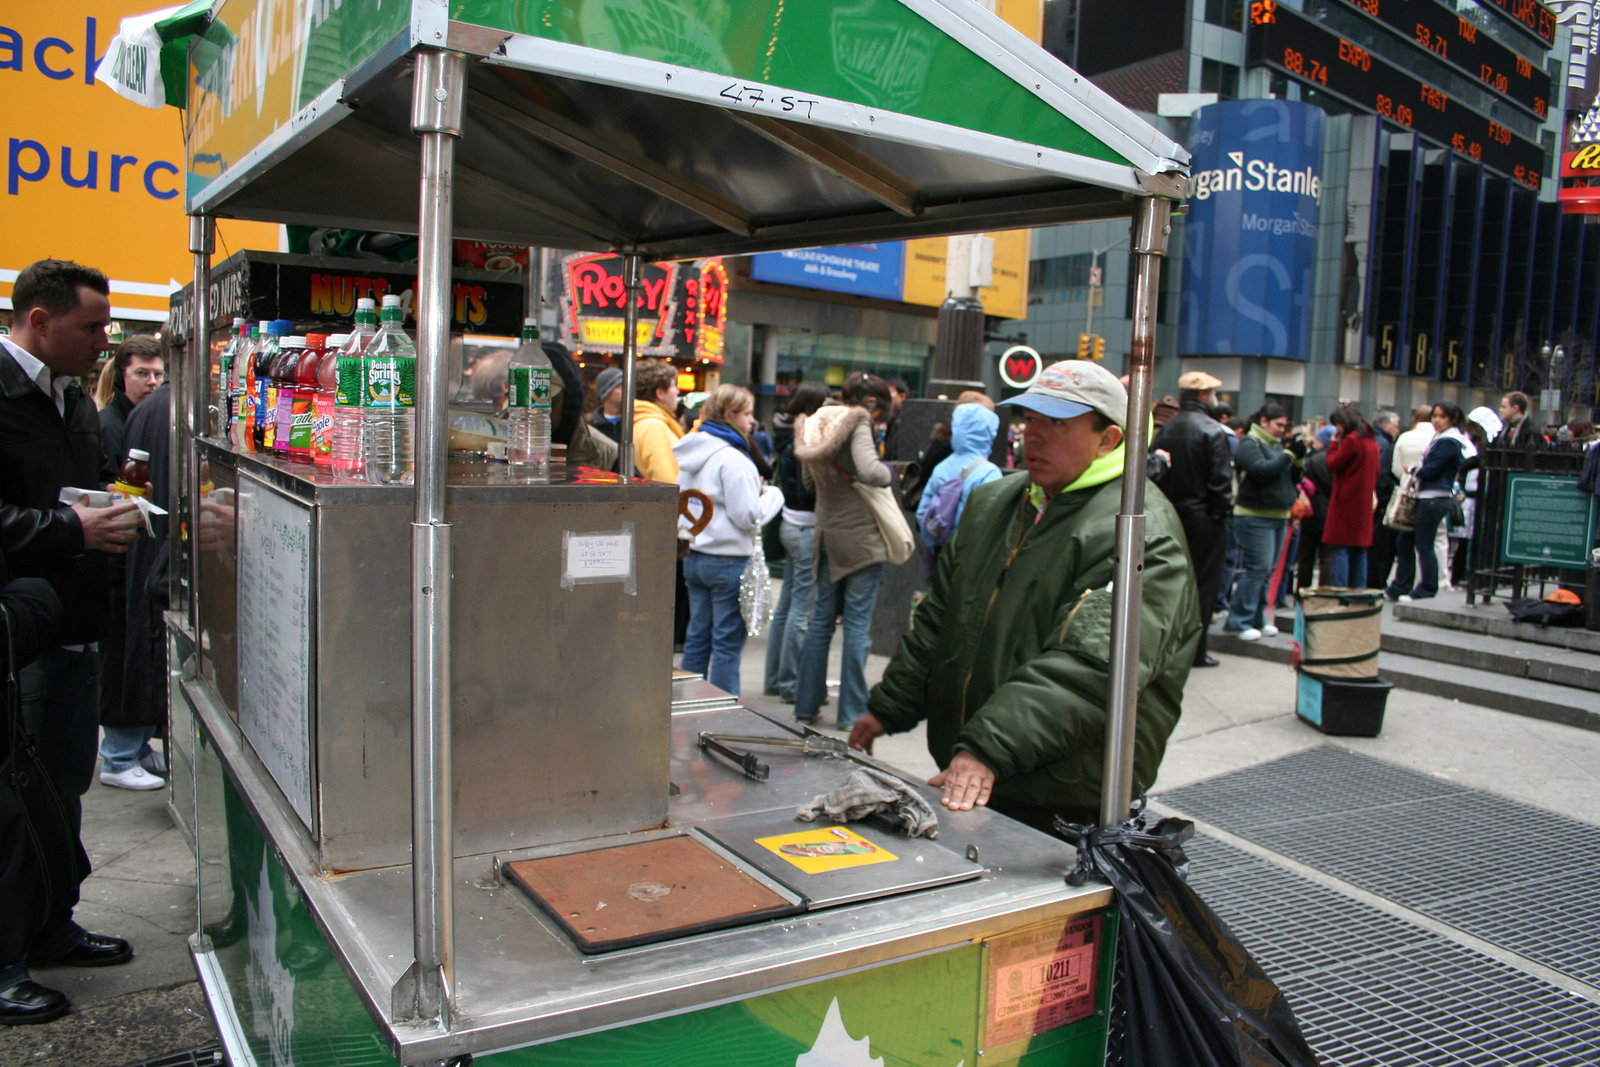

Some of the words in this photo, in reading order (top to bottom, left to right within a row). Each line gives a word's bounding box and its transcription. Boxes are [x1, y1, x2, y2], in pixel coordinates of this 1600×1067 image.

[8, 137, 180, 200] purc
[371, 359, 397, 371] Poland
[1006, 357, 1035, 379] W
[368, 369, 402, 387] Spring
[1039, 959, 1070, 984] 10211
